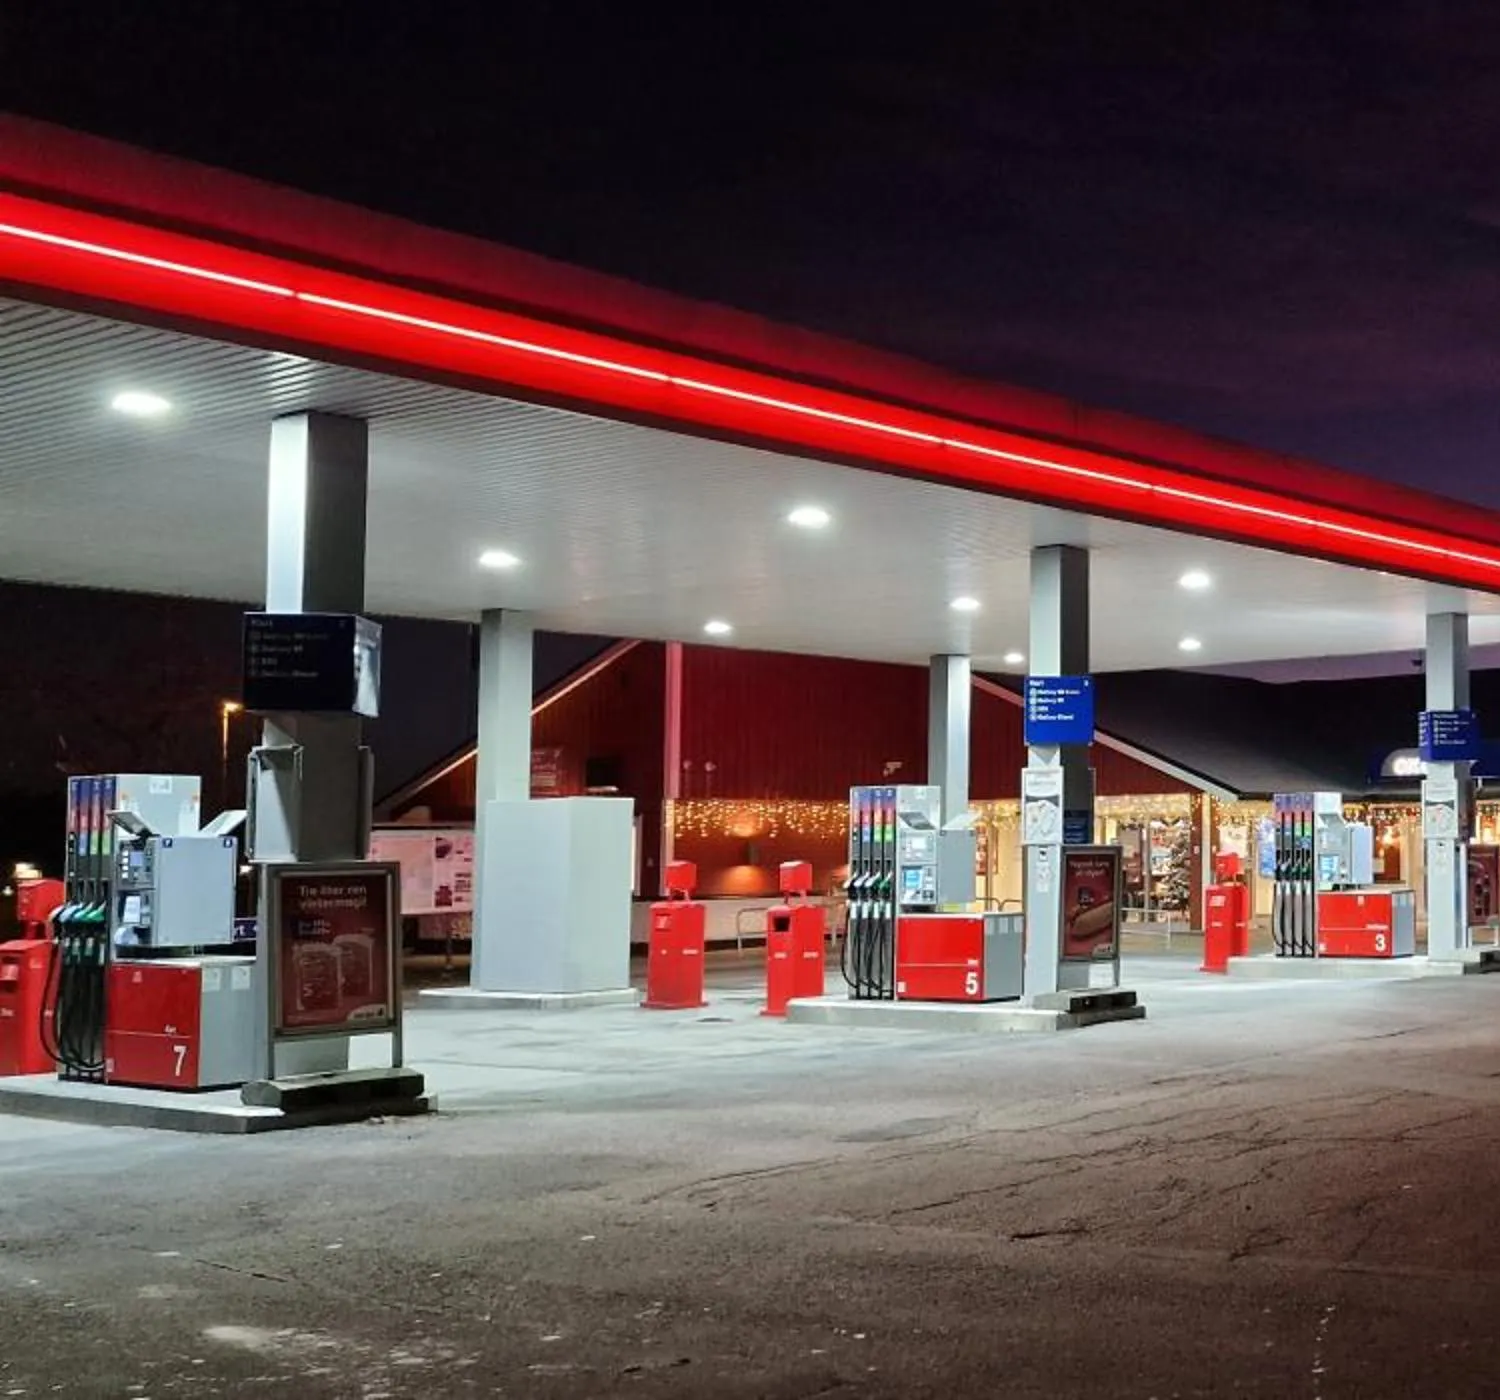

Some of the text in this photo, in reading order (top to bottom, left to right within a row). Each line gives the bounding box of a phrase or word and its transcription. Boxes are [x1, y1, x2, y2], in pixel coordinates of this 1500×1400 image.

[1375, 933, 1386, 952] 3
[965, 971, 979, 995] 5
[173, 1044, 187, 1076] 7
